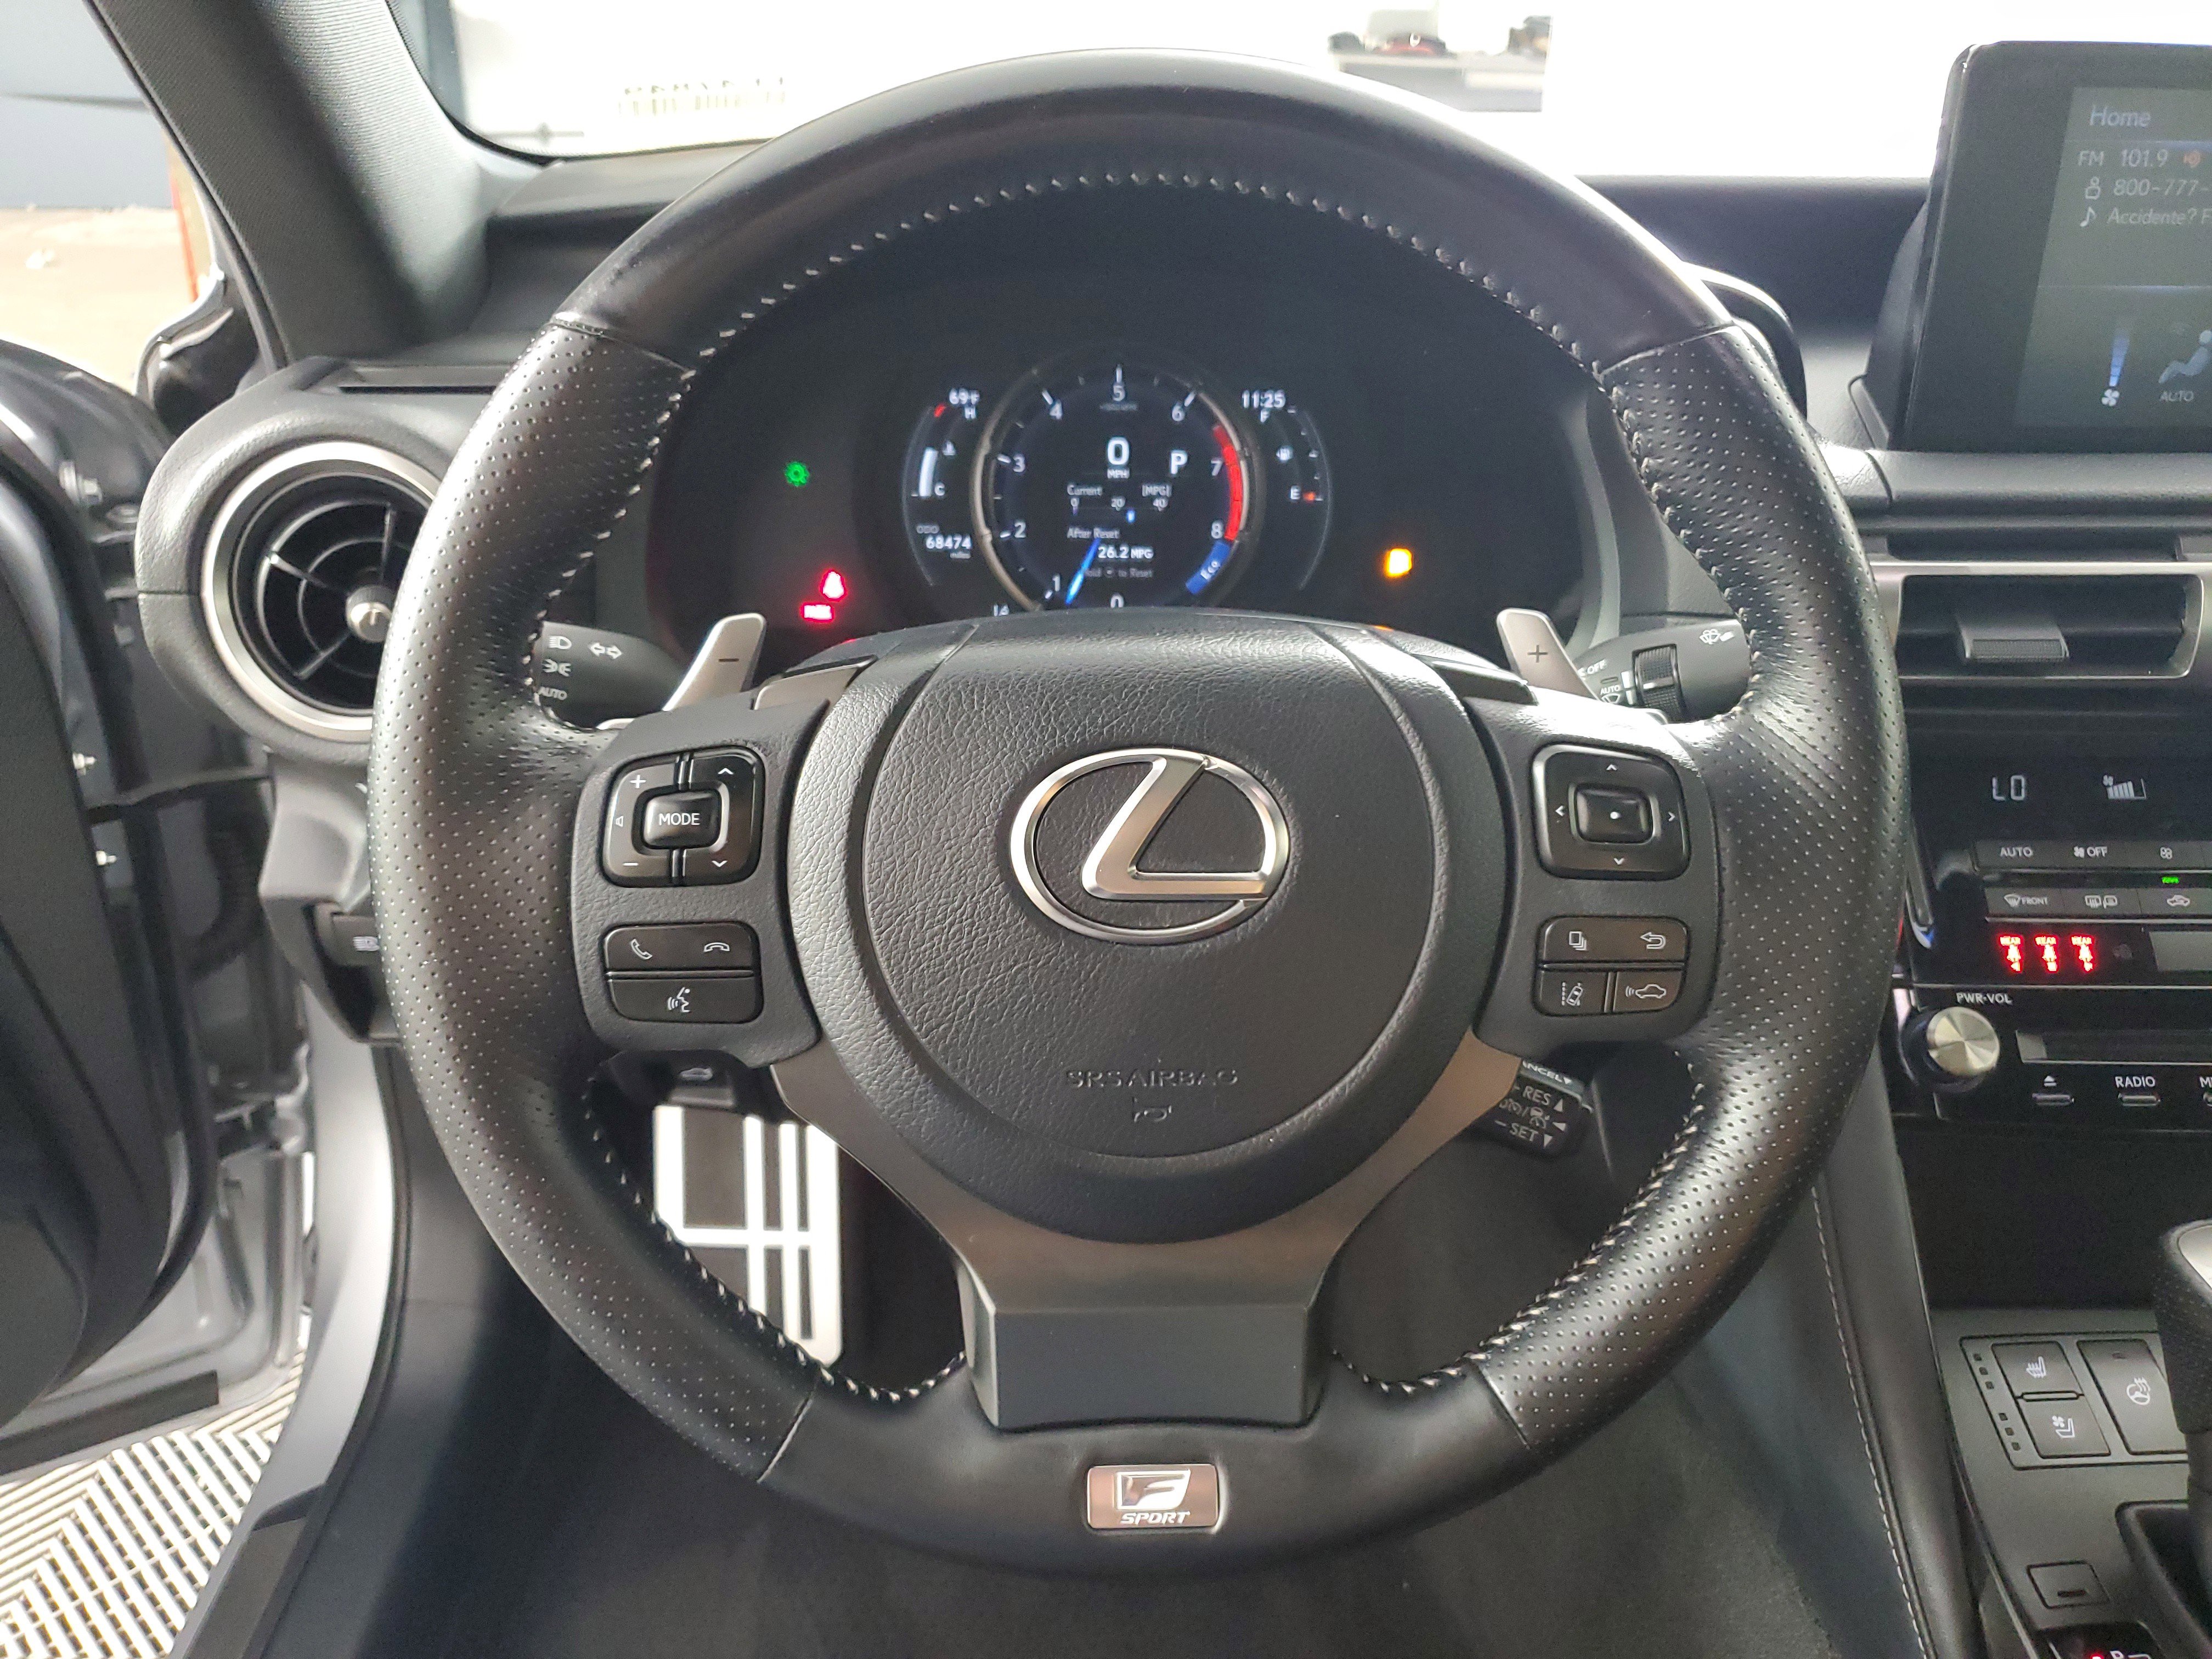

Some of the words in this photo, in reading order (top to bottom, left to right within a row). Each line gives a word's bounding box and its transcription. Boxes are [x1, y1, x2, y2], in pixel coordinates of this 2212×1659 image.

[2089, 106, 2151, 127] Home
[2078, 150, 2104, 166] FM
[2121, 149, 2168, 167] 101.9
[1112, 385, 1125, 402] 5
[1242, 390, 1286, 408] 11:25
[2160, 390, 2194, 402] AUTO
[964, 407, 977, 419] H
[1049, 399, 1063, 420] 4
[1171, 403, 1186, 422] 6
[1260, 409, 1270, 423] F
[1107, 437, 1130, 465] 0
[1013, 453, 1026, 472] 3
[1170, 450, 1188, 475] P
[1211, 458, 1223, 477] 7
[1107, 469, 1130, 479] MPH
[934, 482, 946, 496] C
[1067, 483, 1103, 496] Current
[1290, 486, 1301, 500] E
[1111, 497, 1125, 507] 20
[1153, 497, 1169, 507] 40
[1013, 521, 1026, 539] 2
[1067, 527, 1092, 539] After
[1093, 528, 1120, 539] Reset
[1211, 520, 1224, 539] 8
[926, 534, 973, 549] 68474
[1098, 546, 1128, 558] 26.2
[1131, 548, 1154, 559] MPG
[1052, 574, 1061, 592] 1
[1587, 659, 1606, 674] OFF
[538, 686, 568, 701] AUTO
[1600, 685, 1620, 696] AUTO
[1991, 774, 2027, 801] LO
[658, 812, 701, 826] MODE
[2000, 847, 2034, 857] AUTO
[2086, 847, 2108, 857] OFF
[2022, 897, 2049, 906] FRONT
[1068, 1070, 1122, 1088] SRS
[1126, 1069, 1238, 1088] AIRBAG
[2115, 1076, 2156, 1088] RADIO
[1522, 1085, 1551, 1106] RES
[1509, 1123, 1539, 1142] SET
[1120, 1511, 1191, 1525] SPORT
